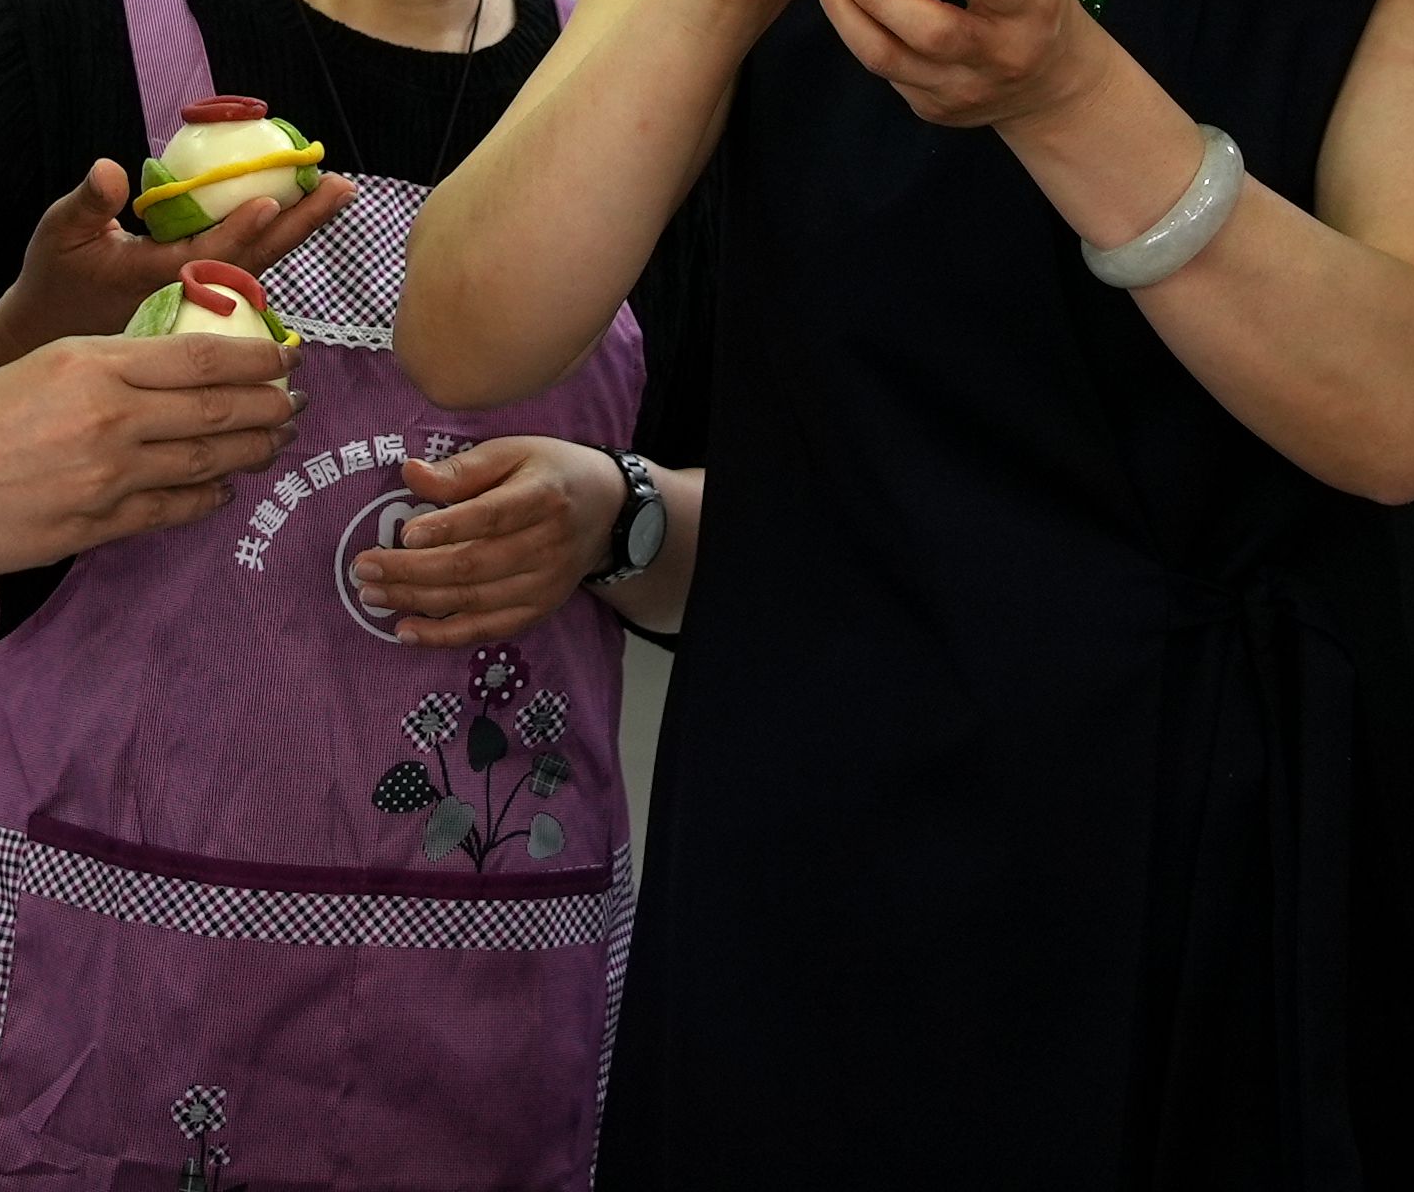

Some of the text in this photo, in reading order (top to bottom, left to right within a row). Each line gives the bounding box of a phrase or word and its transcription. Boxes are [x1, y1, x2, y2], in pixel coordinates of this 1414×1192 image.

[235, 433, 408, 572] 共建美丽庭院
